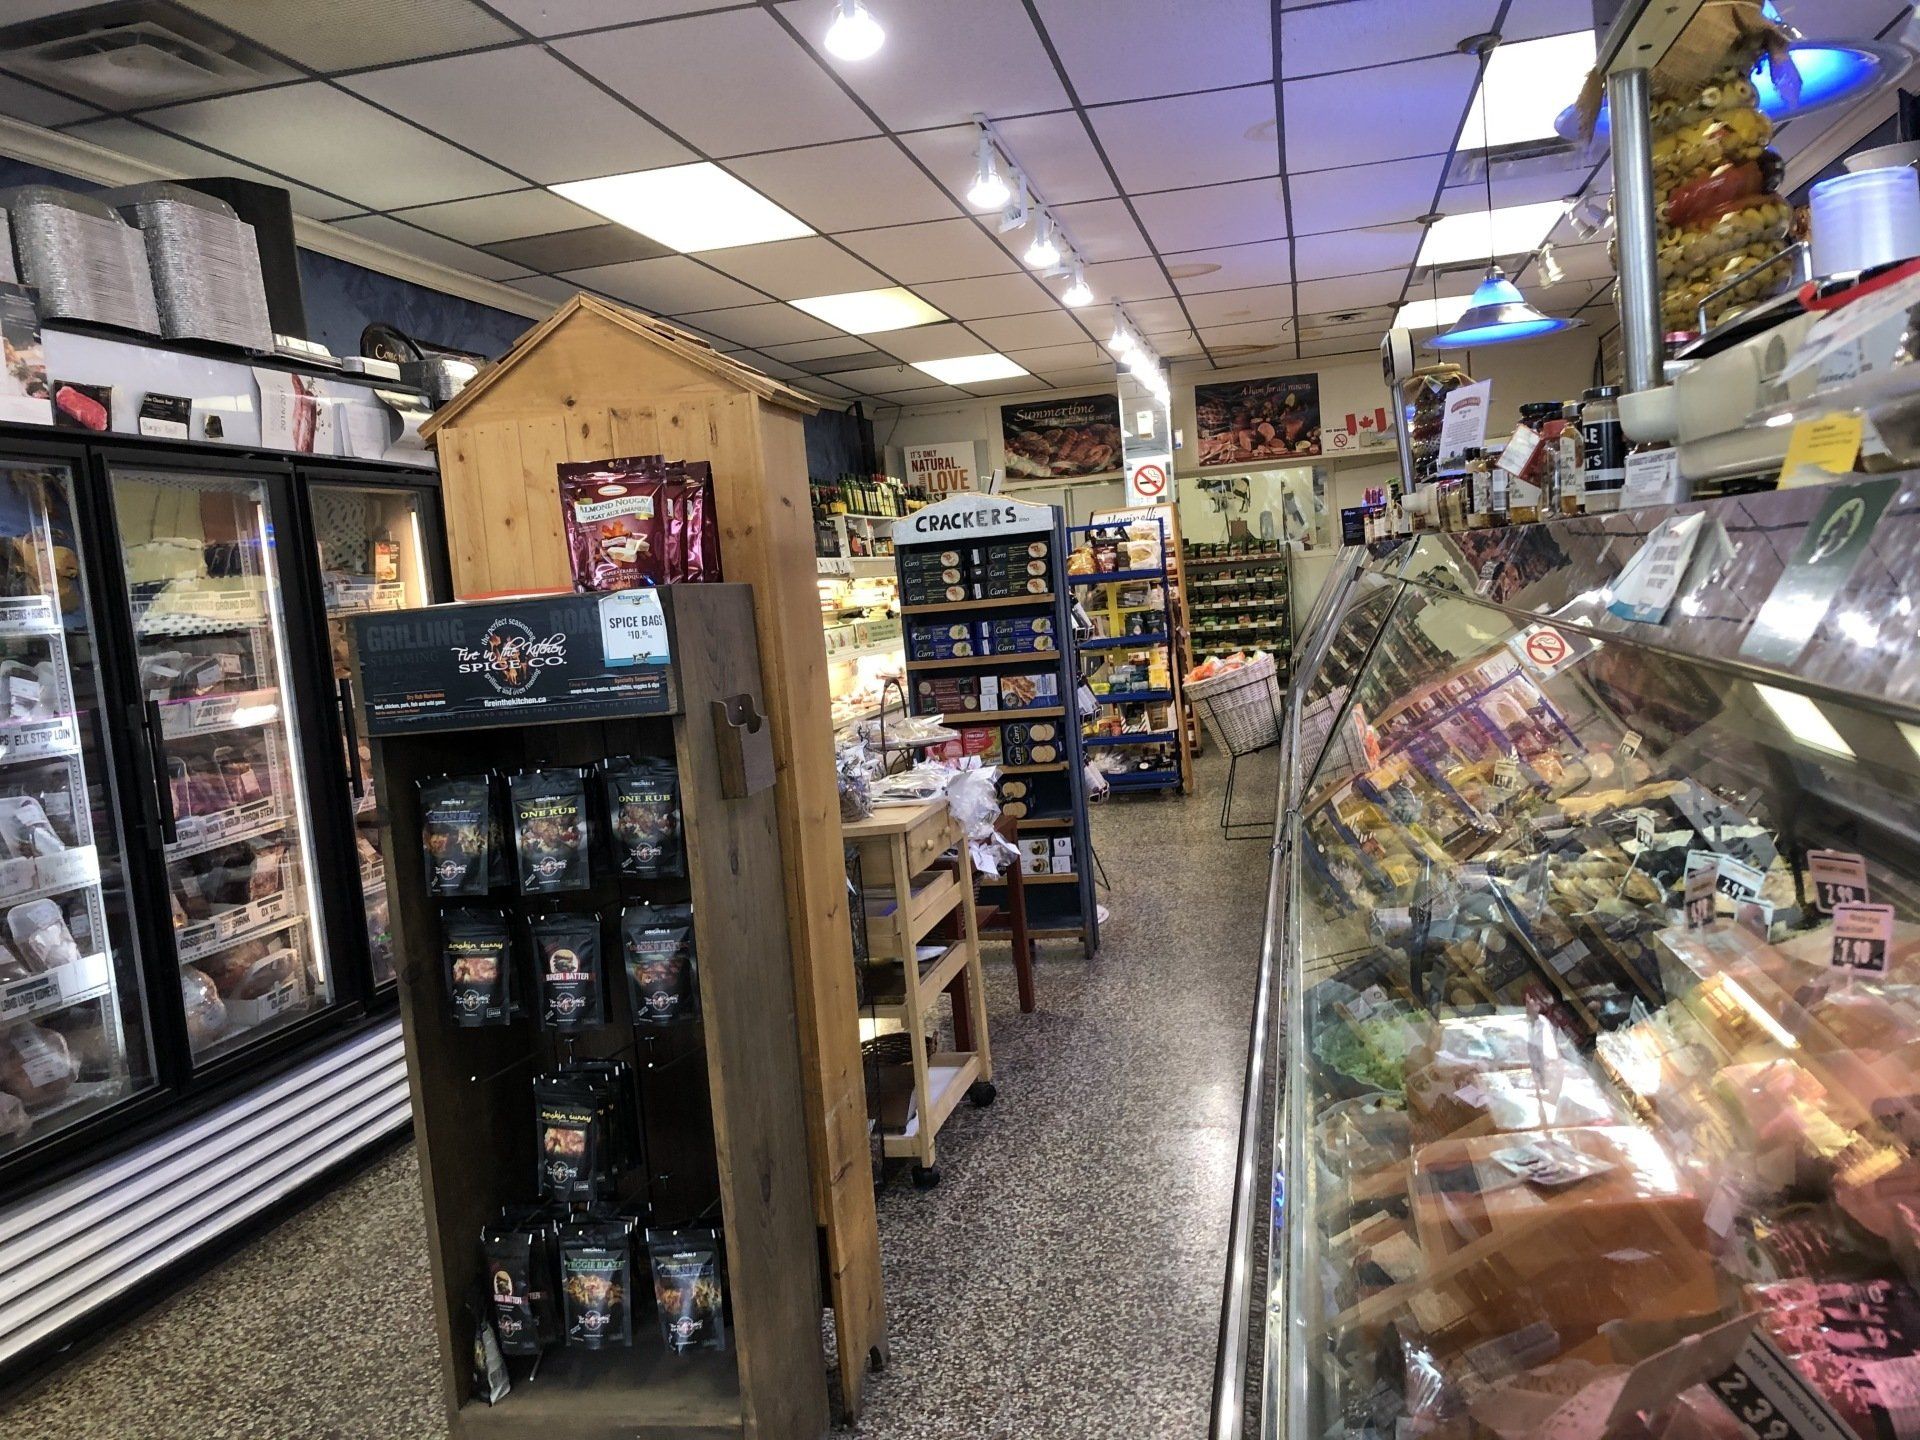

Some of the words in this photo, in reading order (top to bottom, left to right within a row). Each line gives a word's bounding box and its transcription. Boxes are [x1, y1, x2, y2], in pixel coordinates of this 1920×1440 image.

[1014, 402, 1095, 422] Summertime
[910, 450, 921, 459] IT'S
[923, 449, 937, 458] ONLY
[911, 456, 961, 472] NATURAL.
[927, 469, 970, 493] LOVE
[579, 503, 614, 514] ALMOND
[915, 506, 1017, 532] CRACKERS
[609, 616, 638, 629] SPICE
[641, 615, 663, 627] BAGS
[367, 618, 466, 652] GRILLING
[459, 659, 521, 674] SPICE
[528, 656, 567, 668] CO.
[484, 697, 547, 707] fireinthekitchen.ca
[14, 733, 29, 746] ELK
[30, 730, 53, 744] STRIP
[54, 728, 71, 741] LOIN
[644, 794, 671, 802] RUB
[520, 809, 546, 819] ONE
[549, 807, 577, 815] RUB
